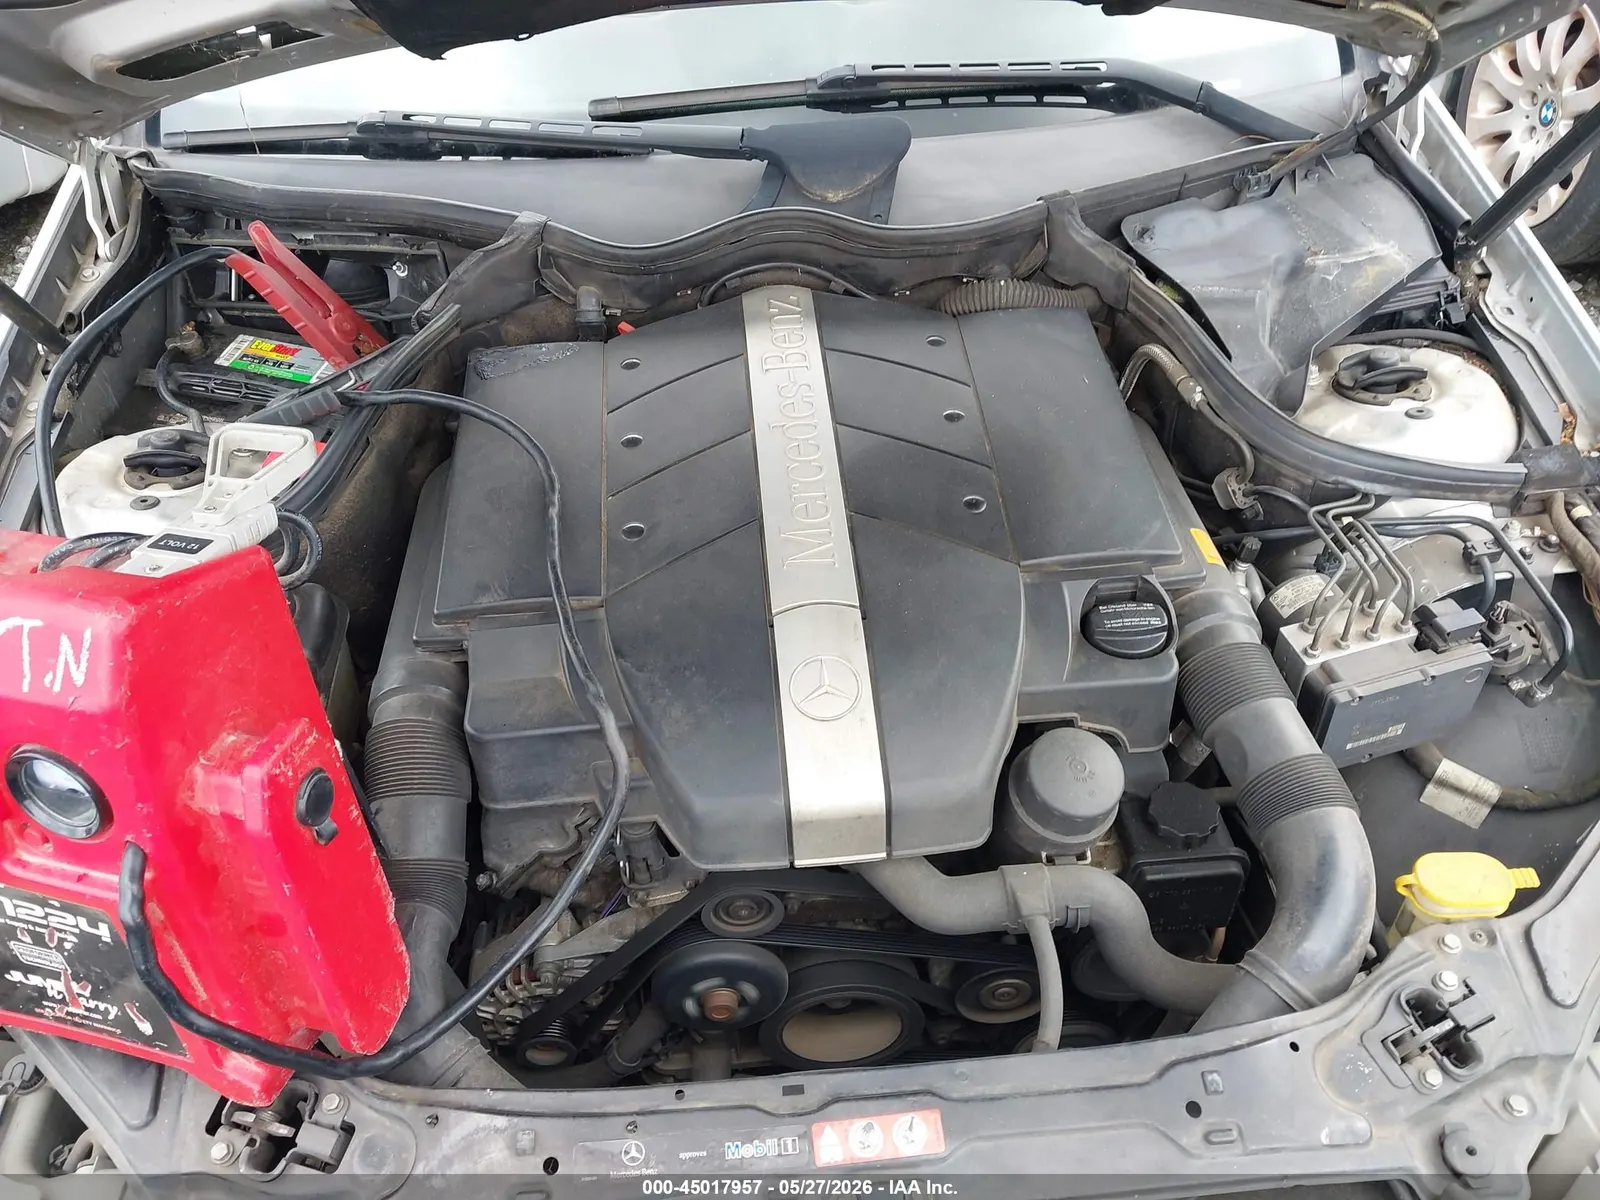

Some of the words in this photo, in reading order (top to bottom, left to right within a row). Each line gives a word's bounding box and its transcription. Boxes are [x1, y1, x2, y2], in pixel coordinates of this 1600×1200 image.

[760, 295, 839, 569] Mercedes-Benz
[158, 539, 186, 548] VOLT
[725, 1138, 778, 1160] Mobil
